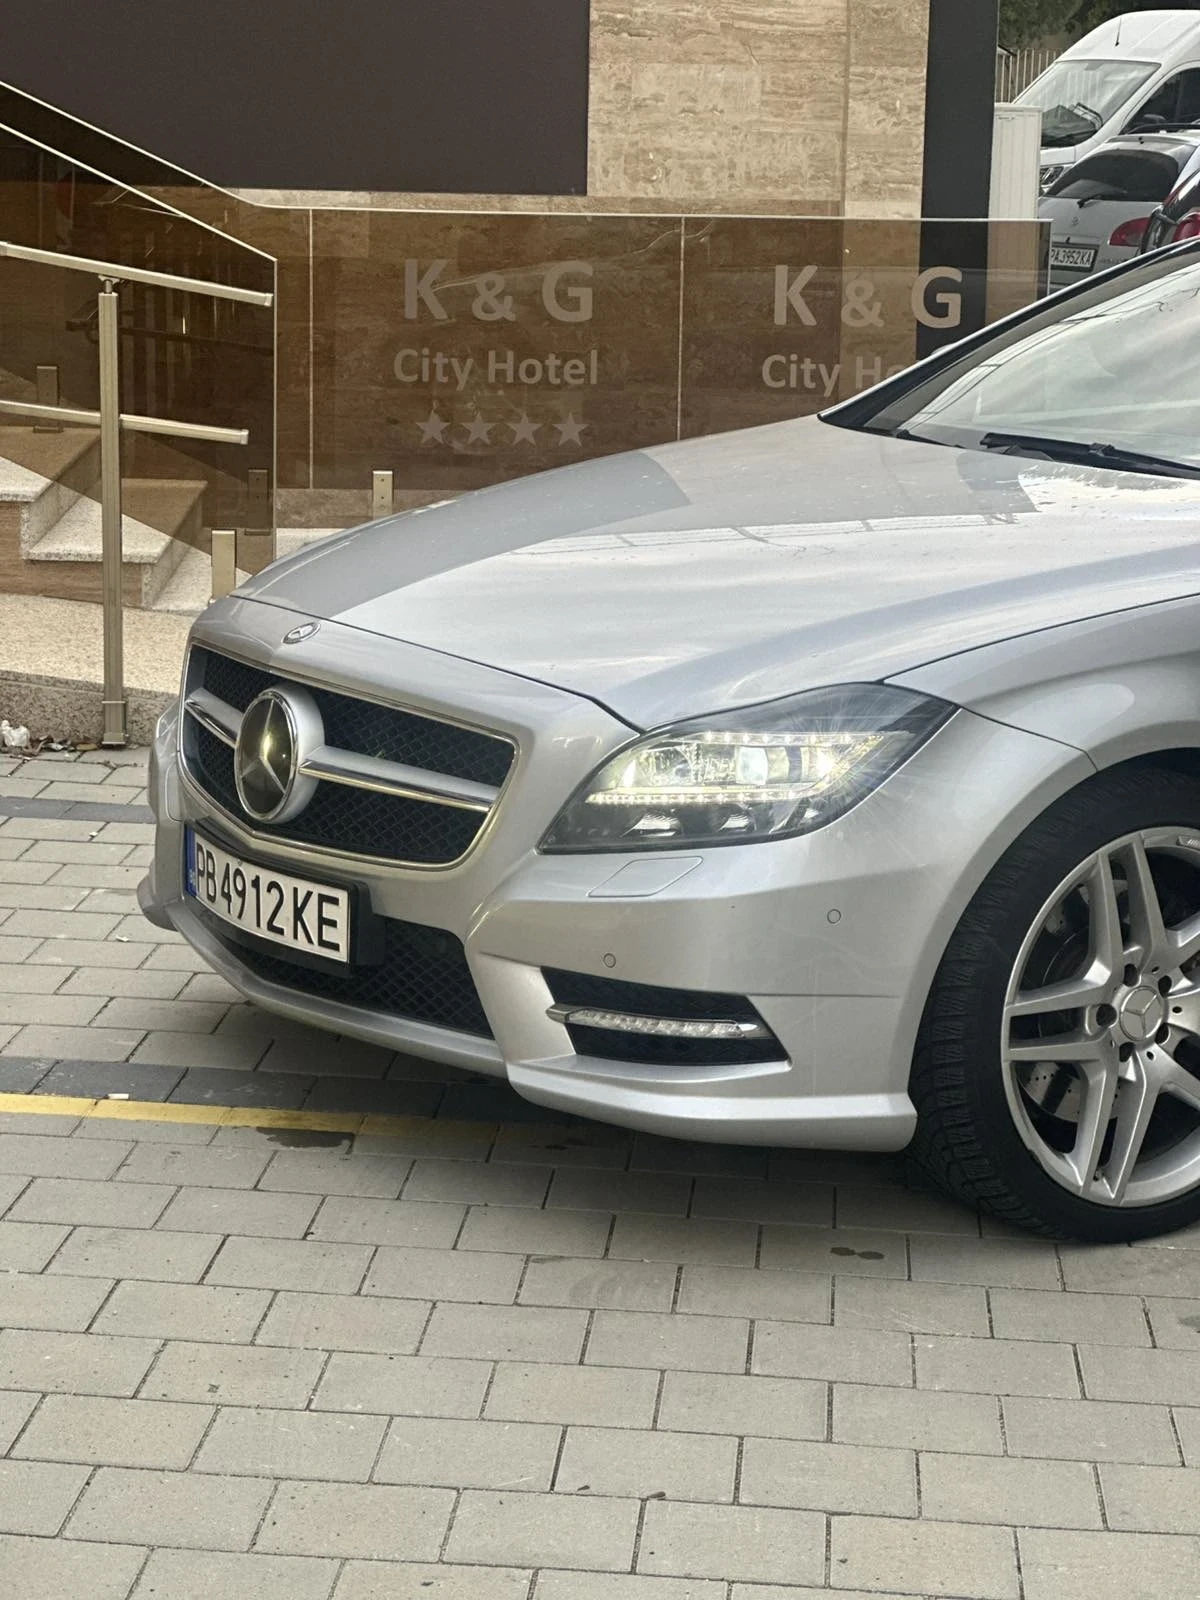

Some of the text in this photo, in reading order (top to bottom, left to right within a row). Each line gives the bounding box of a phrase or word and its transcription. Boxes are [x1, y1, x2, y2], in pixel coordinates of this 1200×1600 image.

[404, 258, 593, 322] K & G
[774, 264, 963, 328] K & G
[393, 347, 598, 391] City Hotel
[761, 353, 841, 398] City
